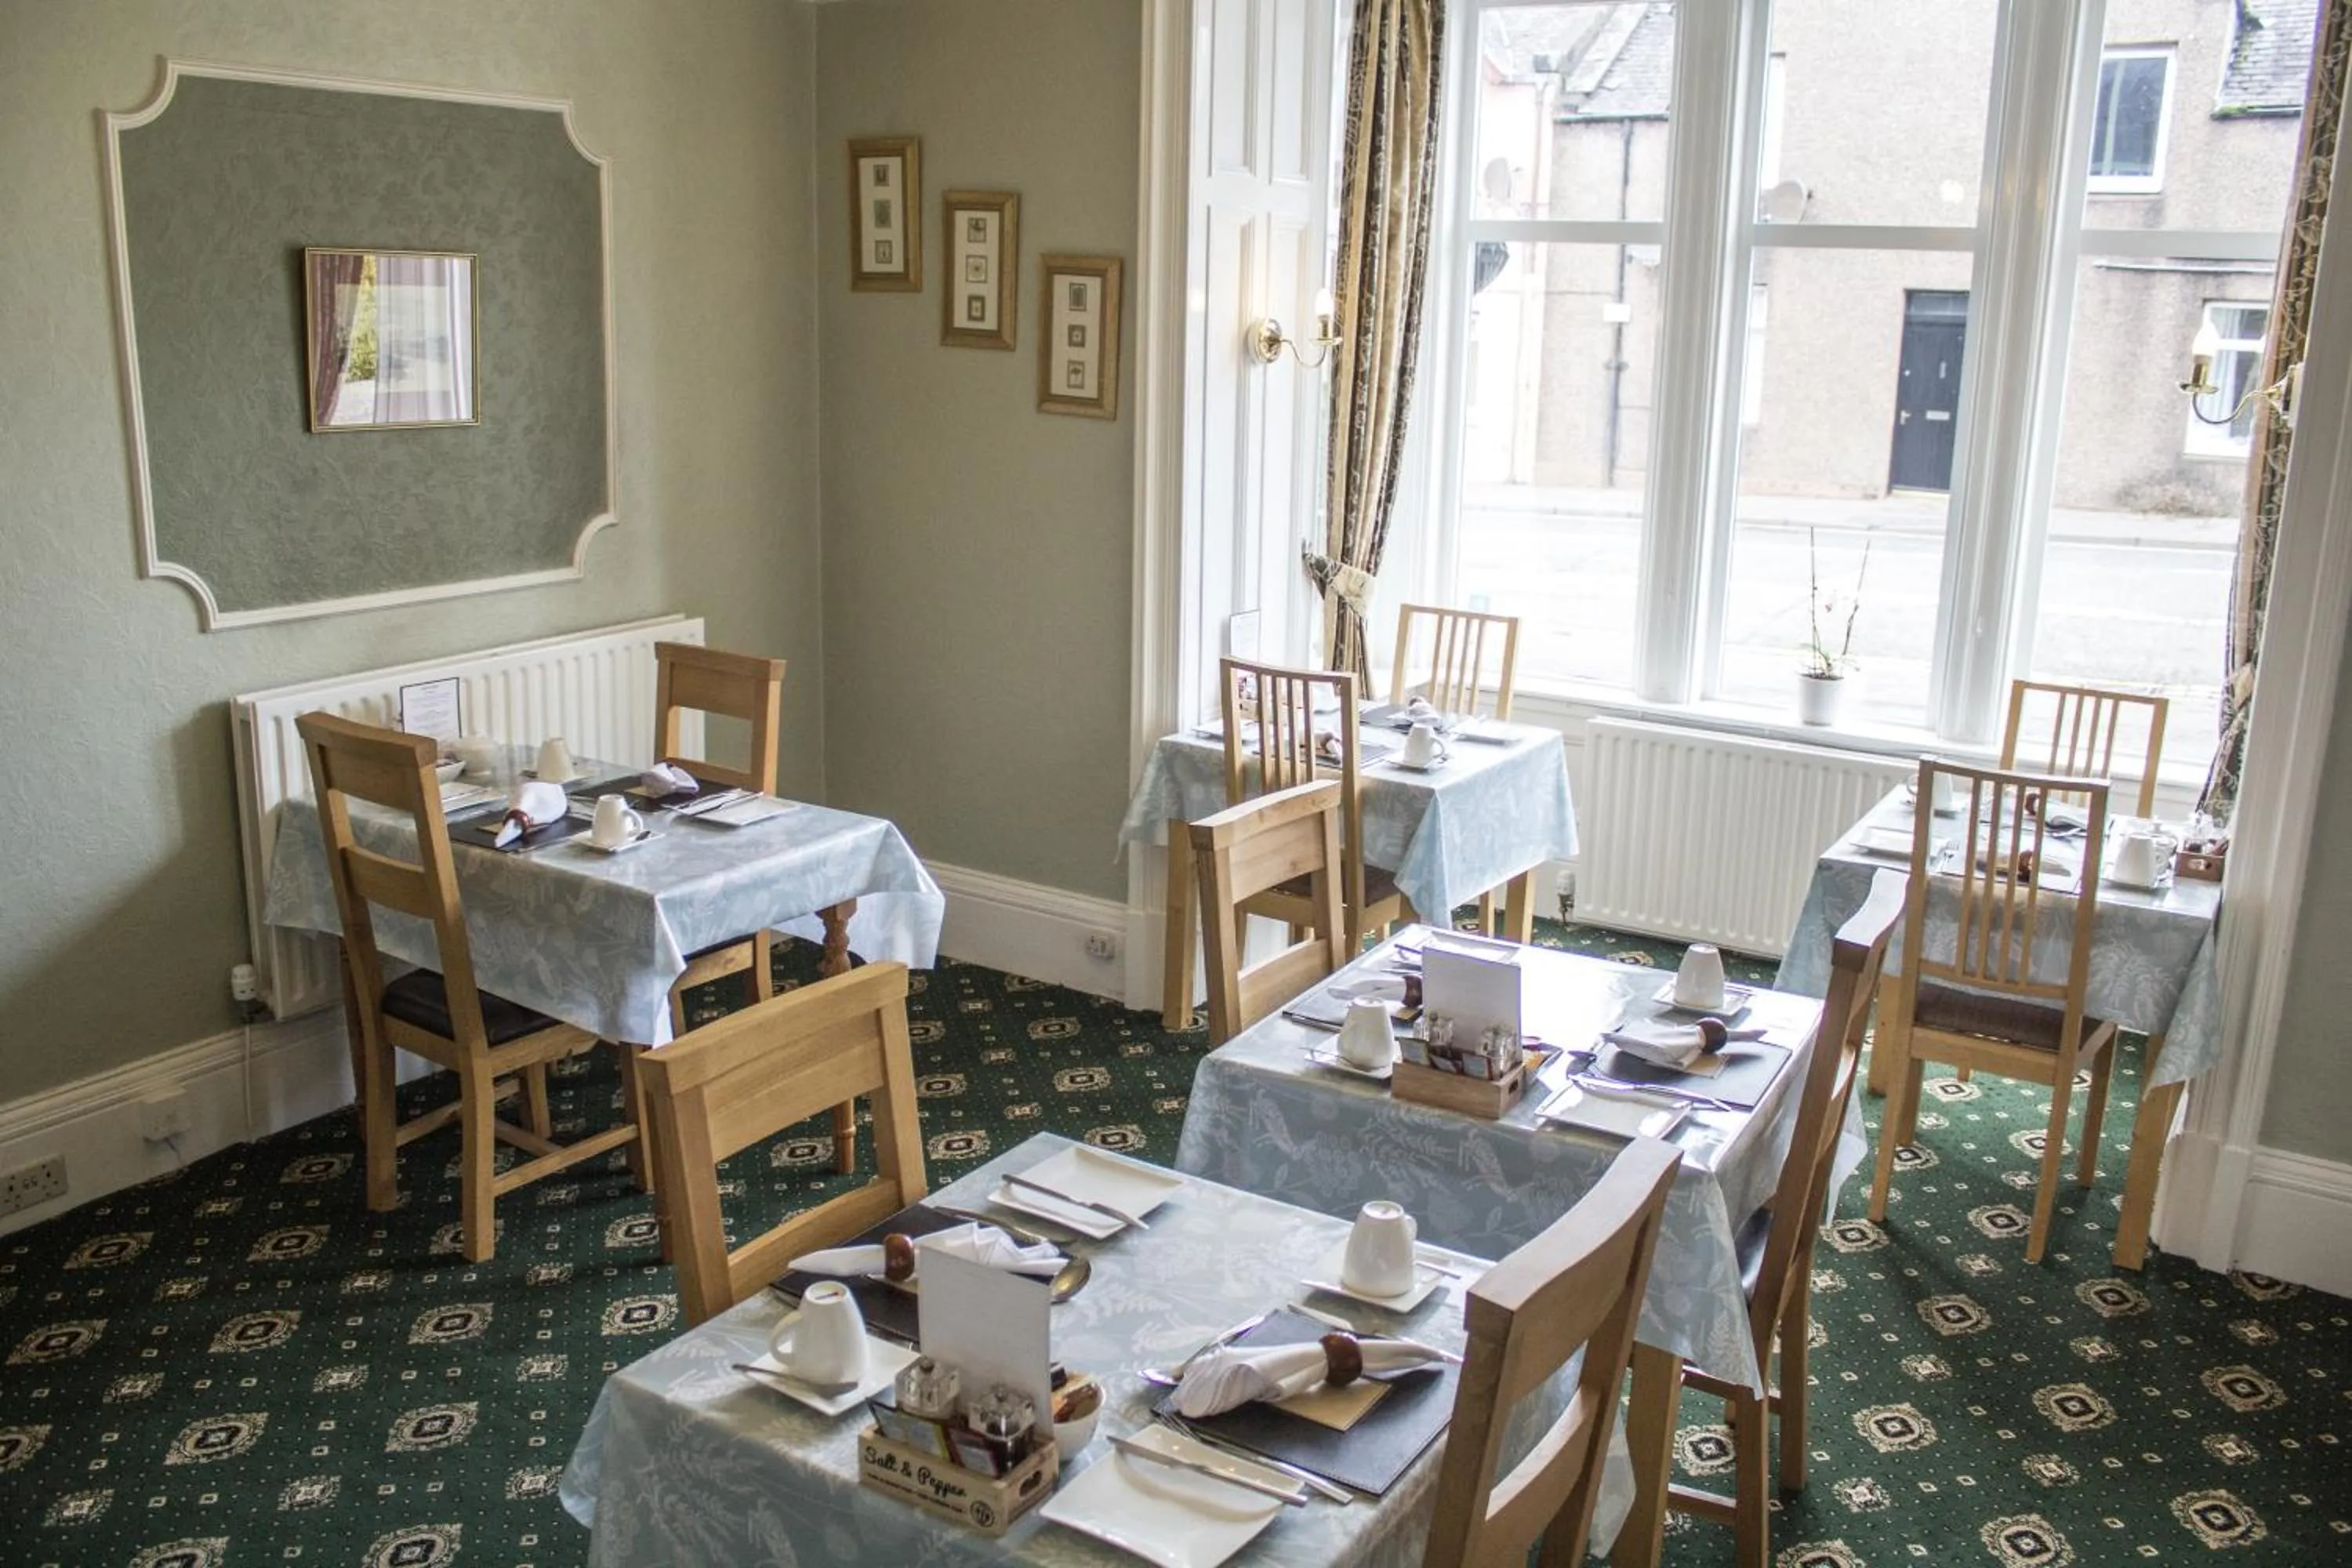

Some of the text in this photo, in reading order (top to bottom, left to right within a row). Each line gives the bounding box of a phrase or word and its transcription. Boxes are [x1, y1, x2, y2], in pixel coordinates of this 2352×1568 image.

[865, 1446, 897, 1472] Salt
[901, 1461, 912, 1478] &
[917, 1466, 966, 1498] Pepper
